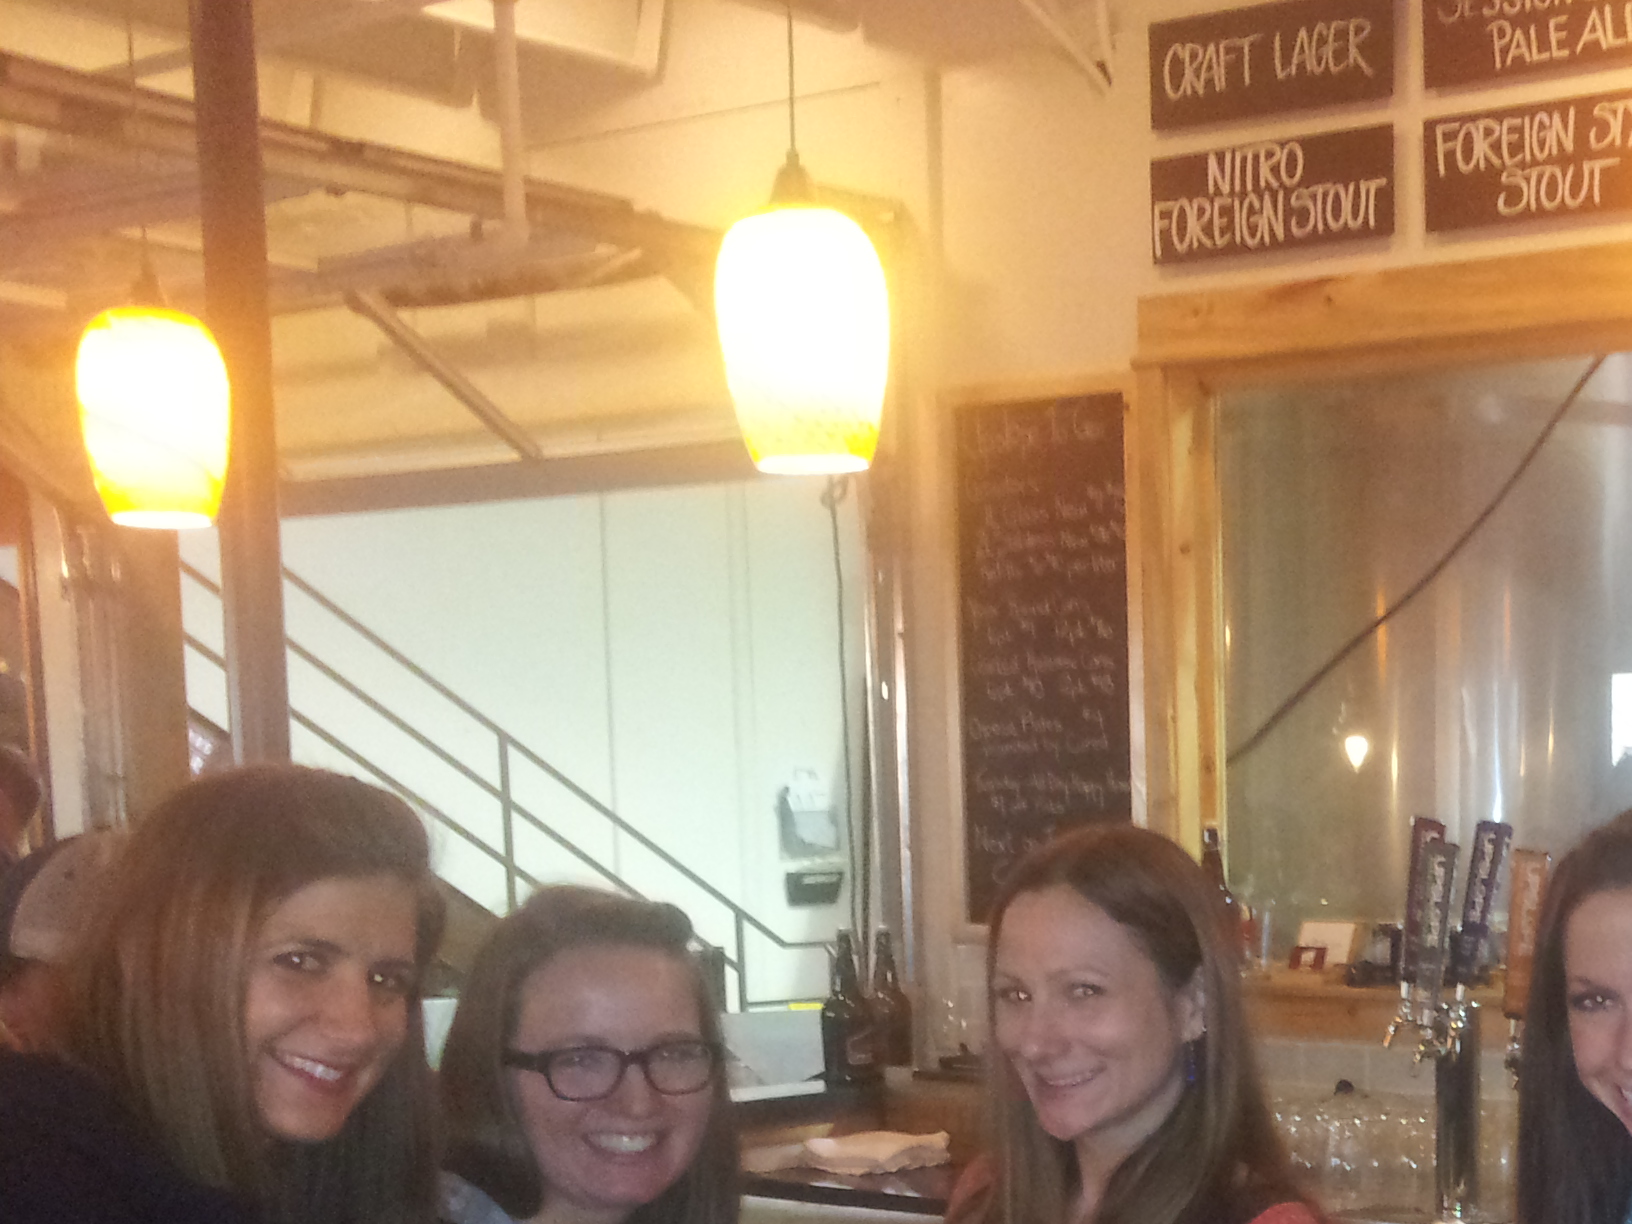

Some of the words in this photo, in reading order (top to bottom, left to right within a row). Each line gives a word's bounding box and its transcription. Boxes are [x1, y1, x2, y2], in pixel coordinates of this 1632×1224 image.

[1164, 33, 1265, 100] CRAFT
[1272, 18, 1375, 80] LAGER
[1487, 15, 1569, 71] PALE
[1206, 141, 1304, 196] NITRO
[1435, 105, 1576, 178] FOREIGN
[1153, 193, 1284, 258] FOREIGN
[1289, 177, 1388, 238] STOUT
[1498, 157, 1621, 217] STOUT
